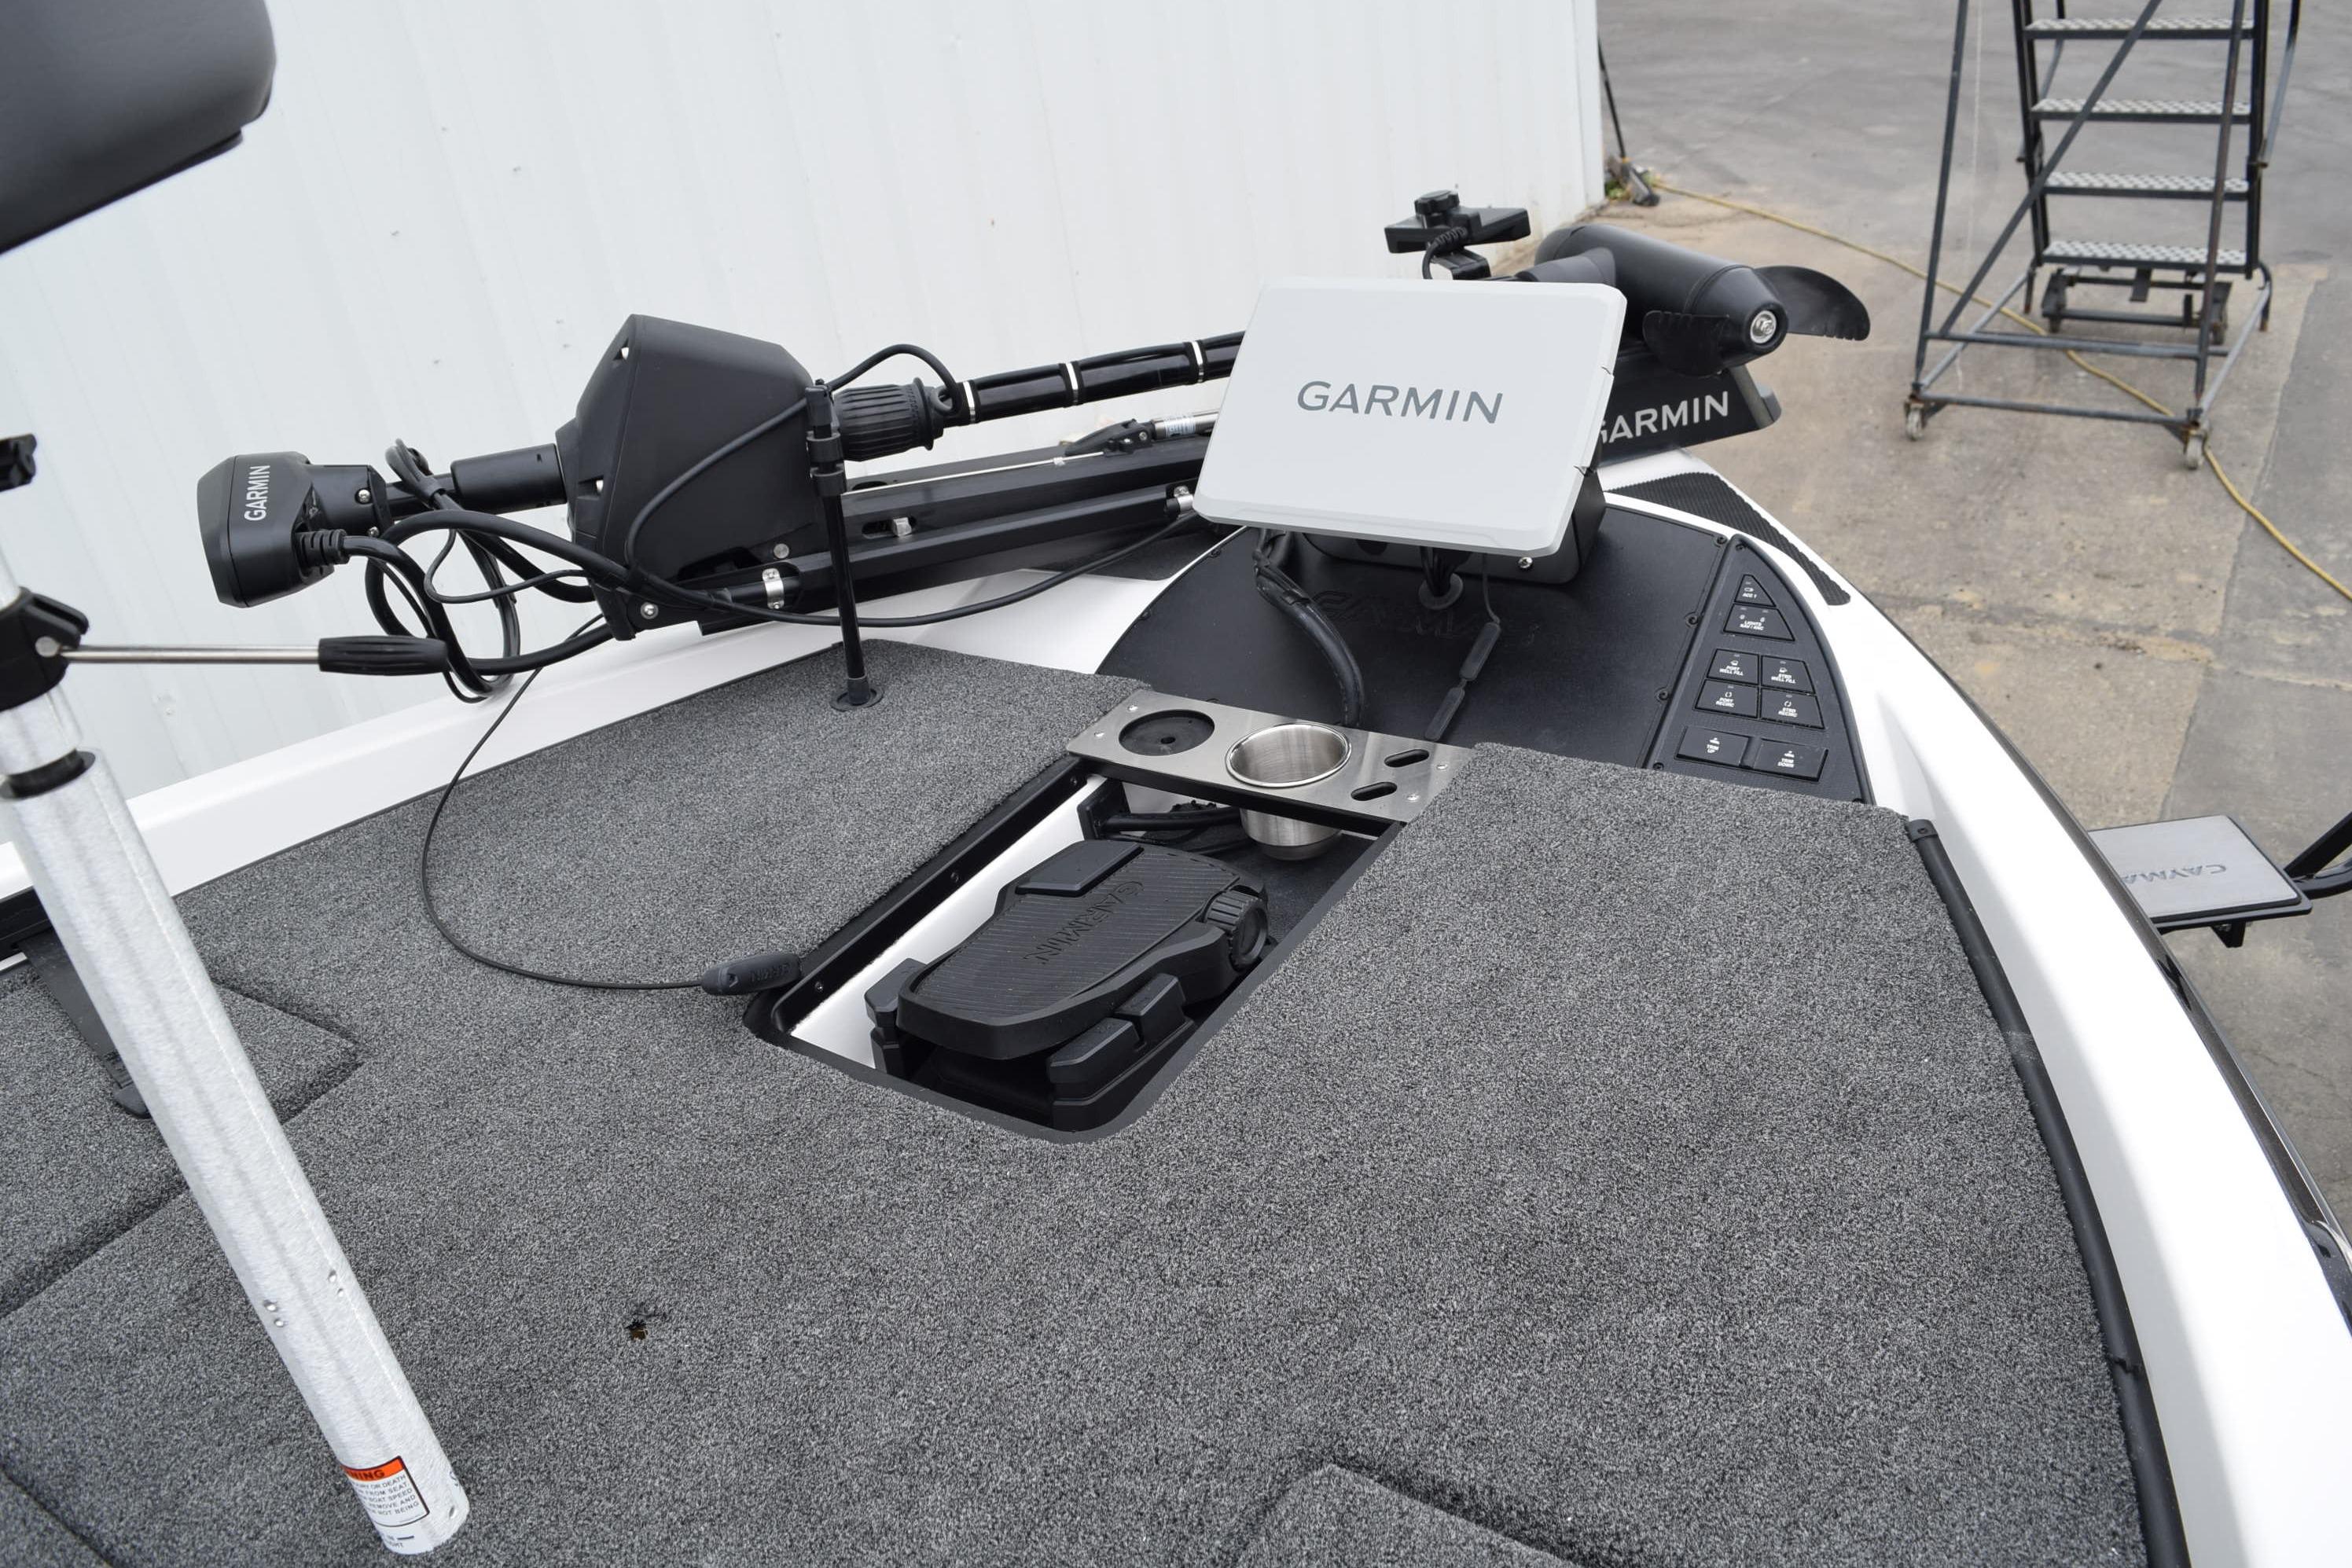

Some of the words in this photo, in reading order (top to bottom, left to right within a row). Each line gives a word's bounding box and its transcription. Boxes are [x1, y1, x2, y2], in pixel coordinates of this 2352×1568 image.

[1297, 380, 1503, 424] GARMIN
[244, 465, 270, 521] GARMIN
[1023, 880, 1145, 966] GARMIN
[383, 1474, 406, 1488] DEATH
[388, 1487, 413, 1500] SPEED
[399, 1494, 416, 1506] AND
[395, 1500, 420, 1515] BEING
